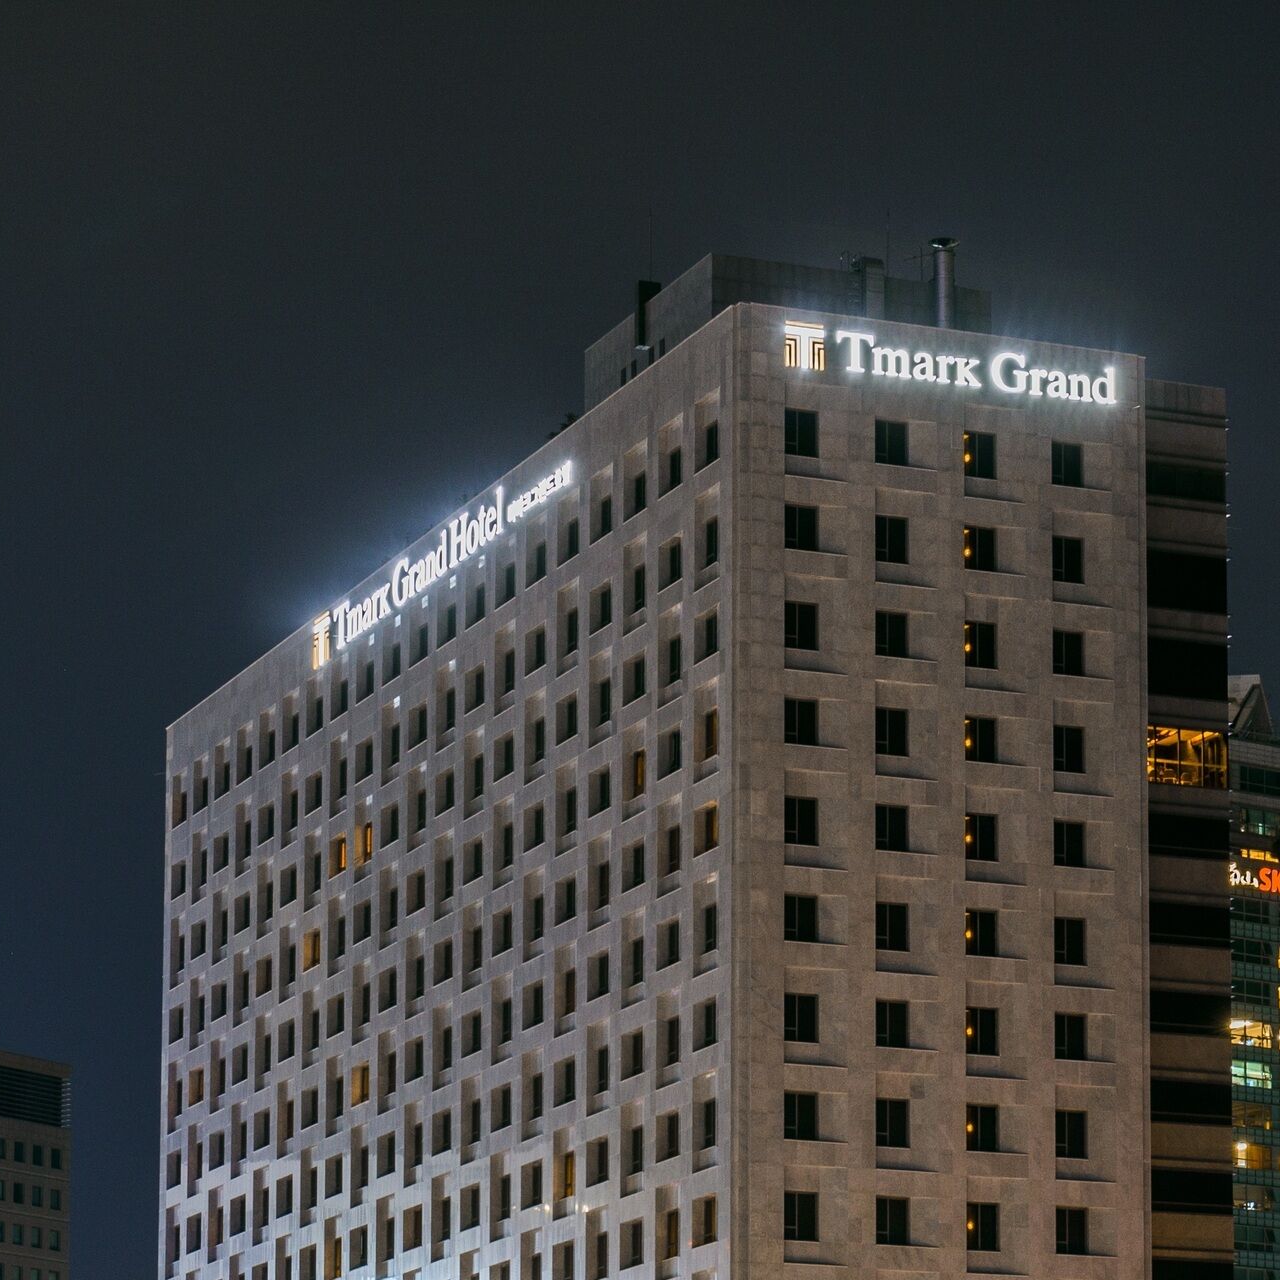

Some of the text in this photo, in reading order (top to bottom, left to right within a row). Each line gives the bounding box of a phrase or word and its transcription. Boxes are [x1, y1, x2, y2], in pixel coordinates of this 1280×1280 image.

[835, 330, 1117, 405] Tmark Grand
[333, 582, 391, 650] Tmark
[391, 529, 448, 607] Grand
[448, 485, 504, 568] Hotel
